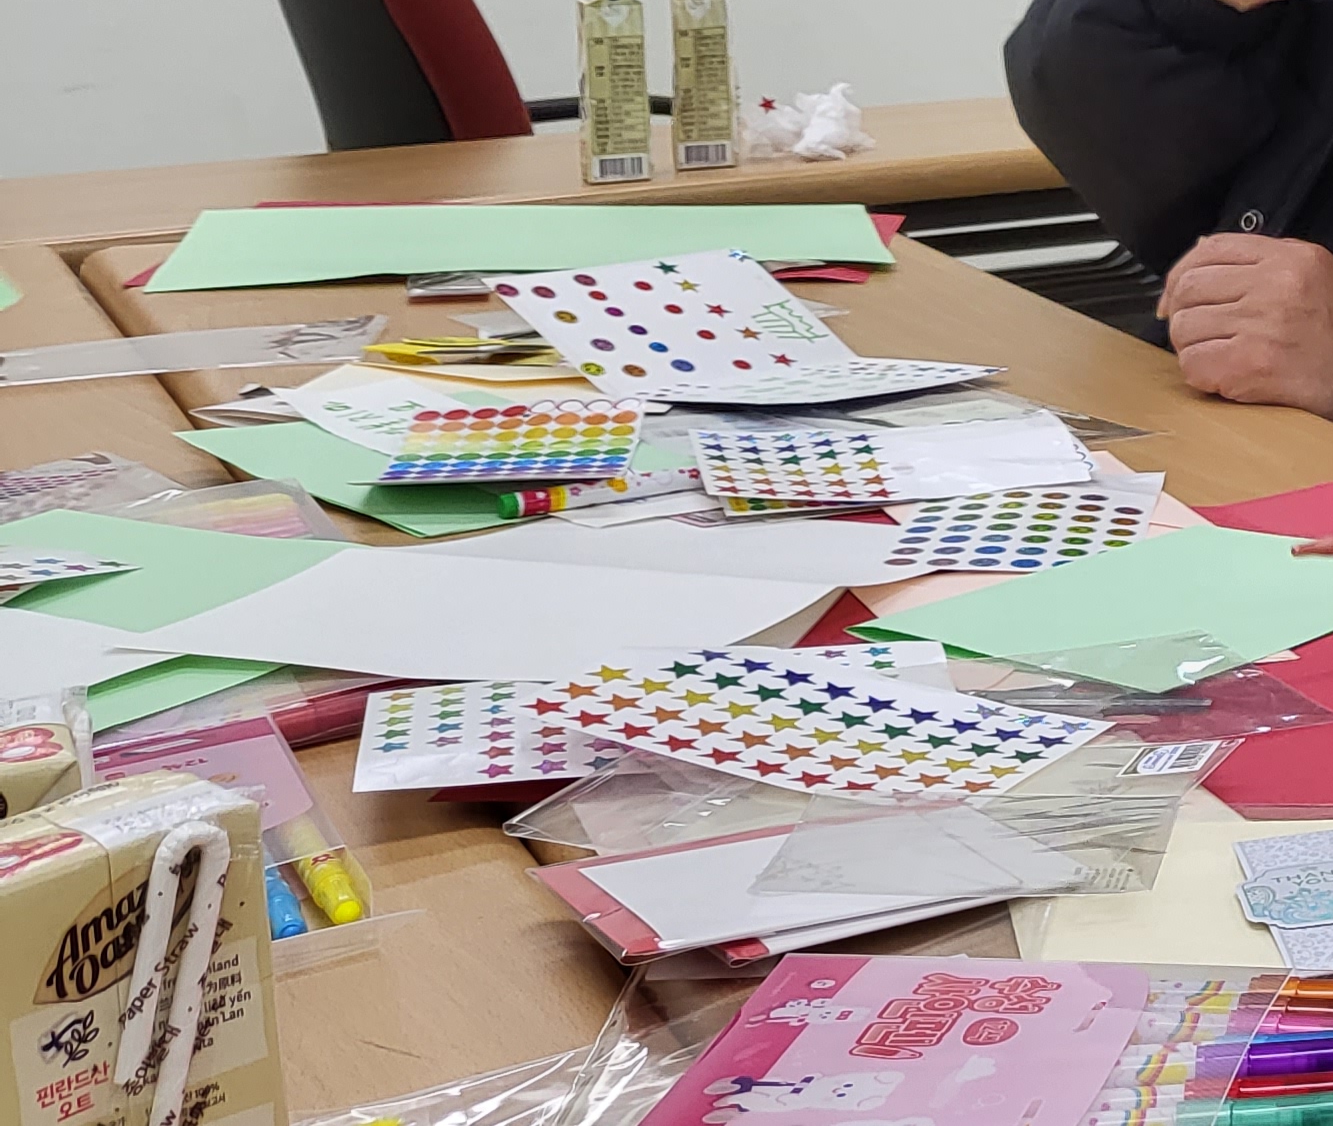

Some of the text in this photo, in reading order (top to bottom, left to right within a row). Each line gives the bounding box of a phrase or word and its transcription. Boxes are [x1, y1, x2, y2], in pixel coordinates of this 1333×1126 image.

[118, 922, 199, 1030] Paper Straw
[970, 976, 1061, 1014] 수성
[222, 1006, 245, 1022] Lan
[857, 972, 990, 1047] 사인펜
[36, 1061, 111, 1109] 핀란드산
[57, 1092, 95, 1123] 오트
